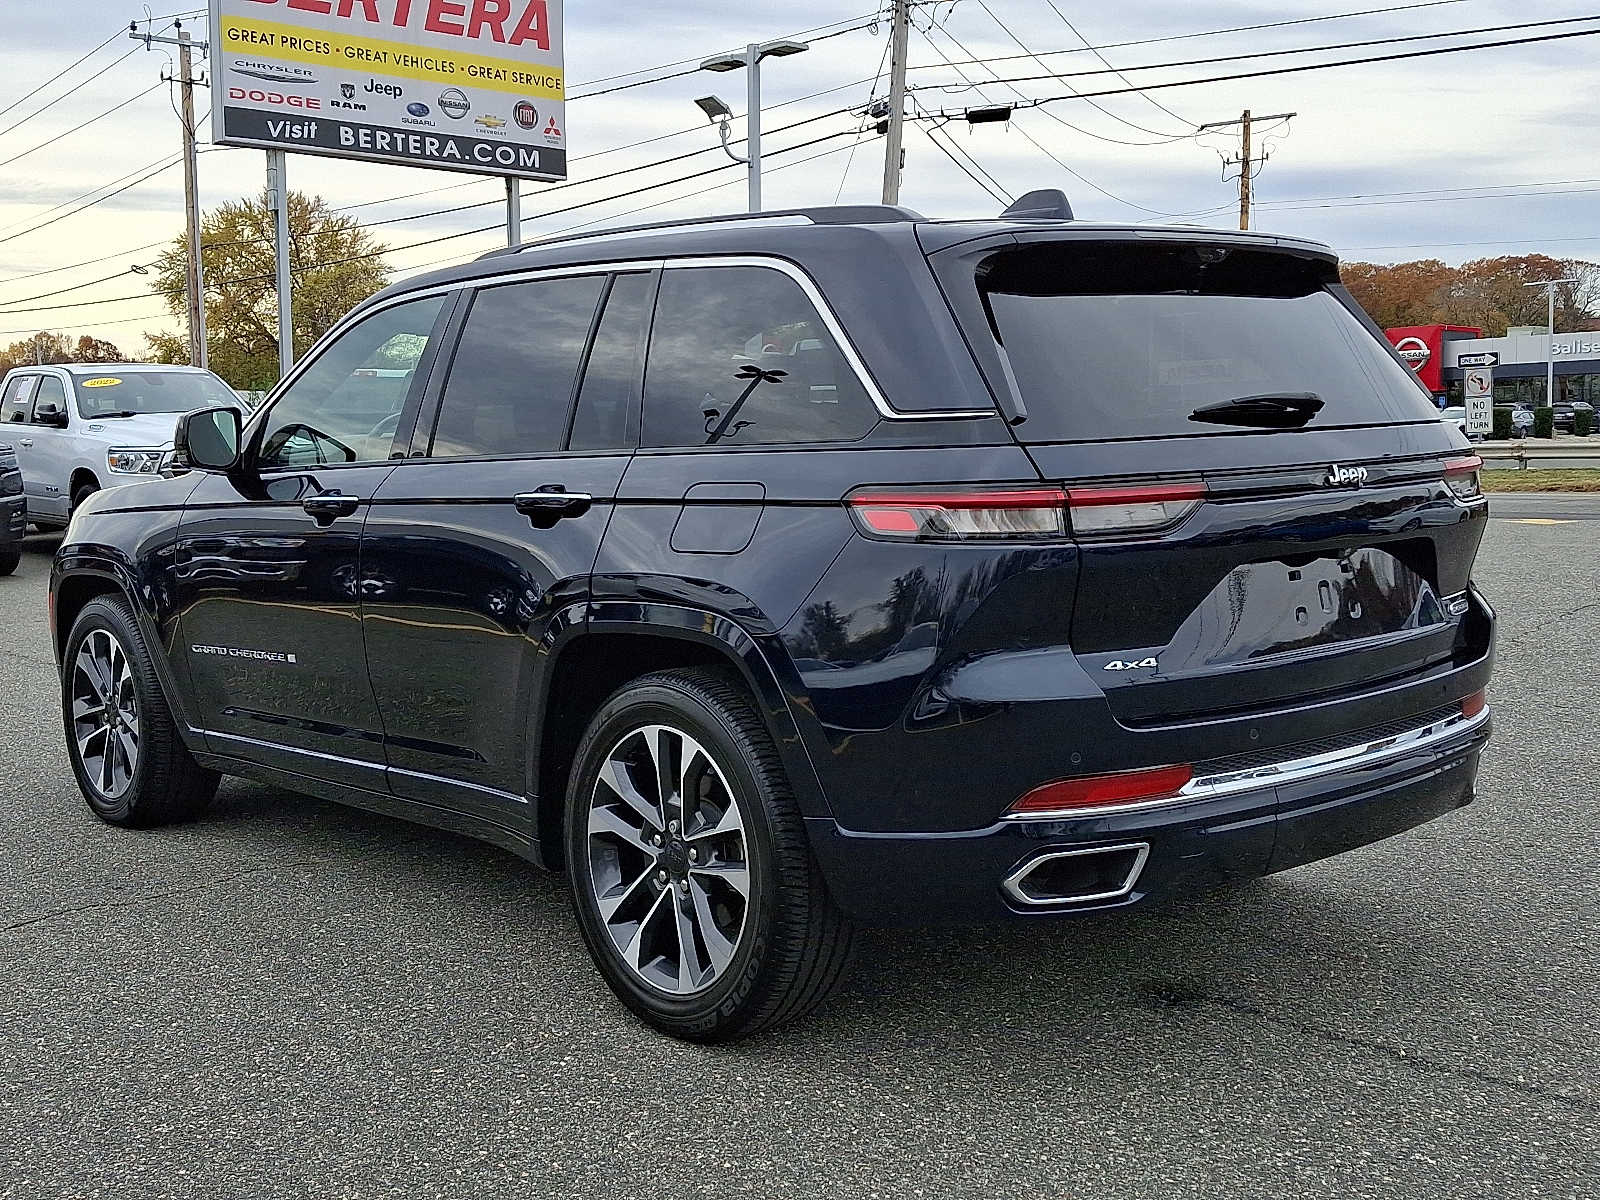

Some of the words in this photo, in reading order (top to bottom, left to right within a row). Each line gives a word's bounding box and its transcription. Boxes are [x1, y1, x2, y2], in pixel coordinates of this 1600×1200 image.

[227, 27, 275, 46] GREAT
[281, 35, 330, 55] PRICES
[344, 46, 388, 64] GREAT
[393, 52, 455, 74] VEHICLES
[467, 65, 508, 82] GREAT
[511, 71, 561, 90] SERVICE
[234, 60, 313, 76] CHRYSLER
[363, 78, 403, 99] Jeep
[228, 87, 321, 110] DODGE
[330, 100, 367, 111] RAM
[440, 99, 468, 109] NISSAN
[401, 117, 436, 127] SUBARU
[519, 108, 534, 123] FIAT
[267, 120, 318, 139] Visit
[339, 126, 540, 169] BERTERA.COM
[1472, 401, 1486, 410] NO
[1470, 411, 1488, 420] LEFT
[1469, 421, 1489, 429] TURN
[1329, 464, 1368, 488] Jeep
[191, 644, 228, 656] GRAND
[228, 648, 287, 662] CHEROKEE
